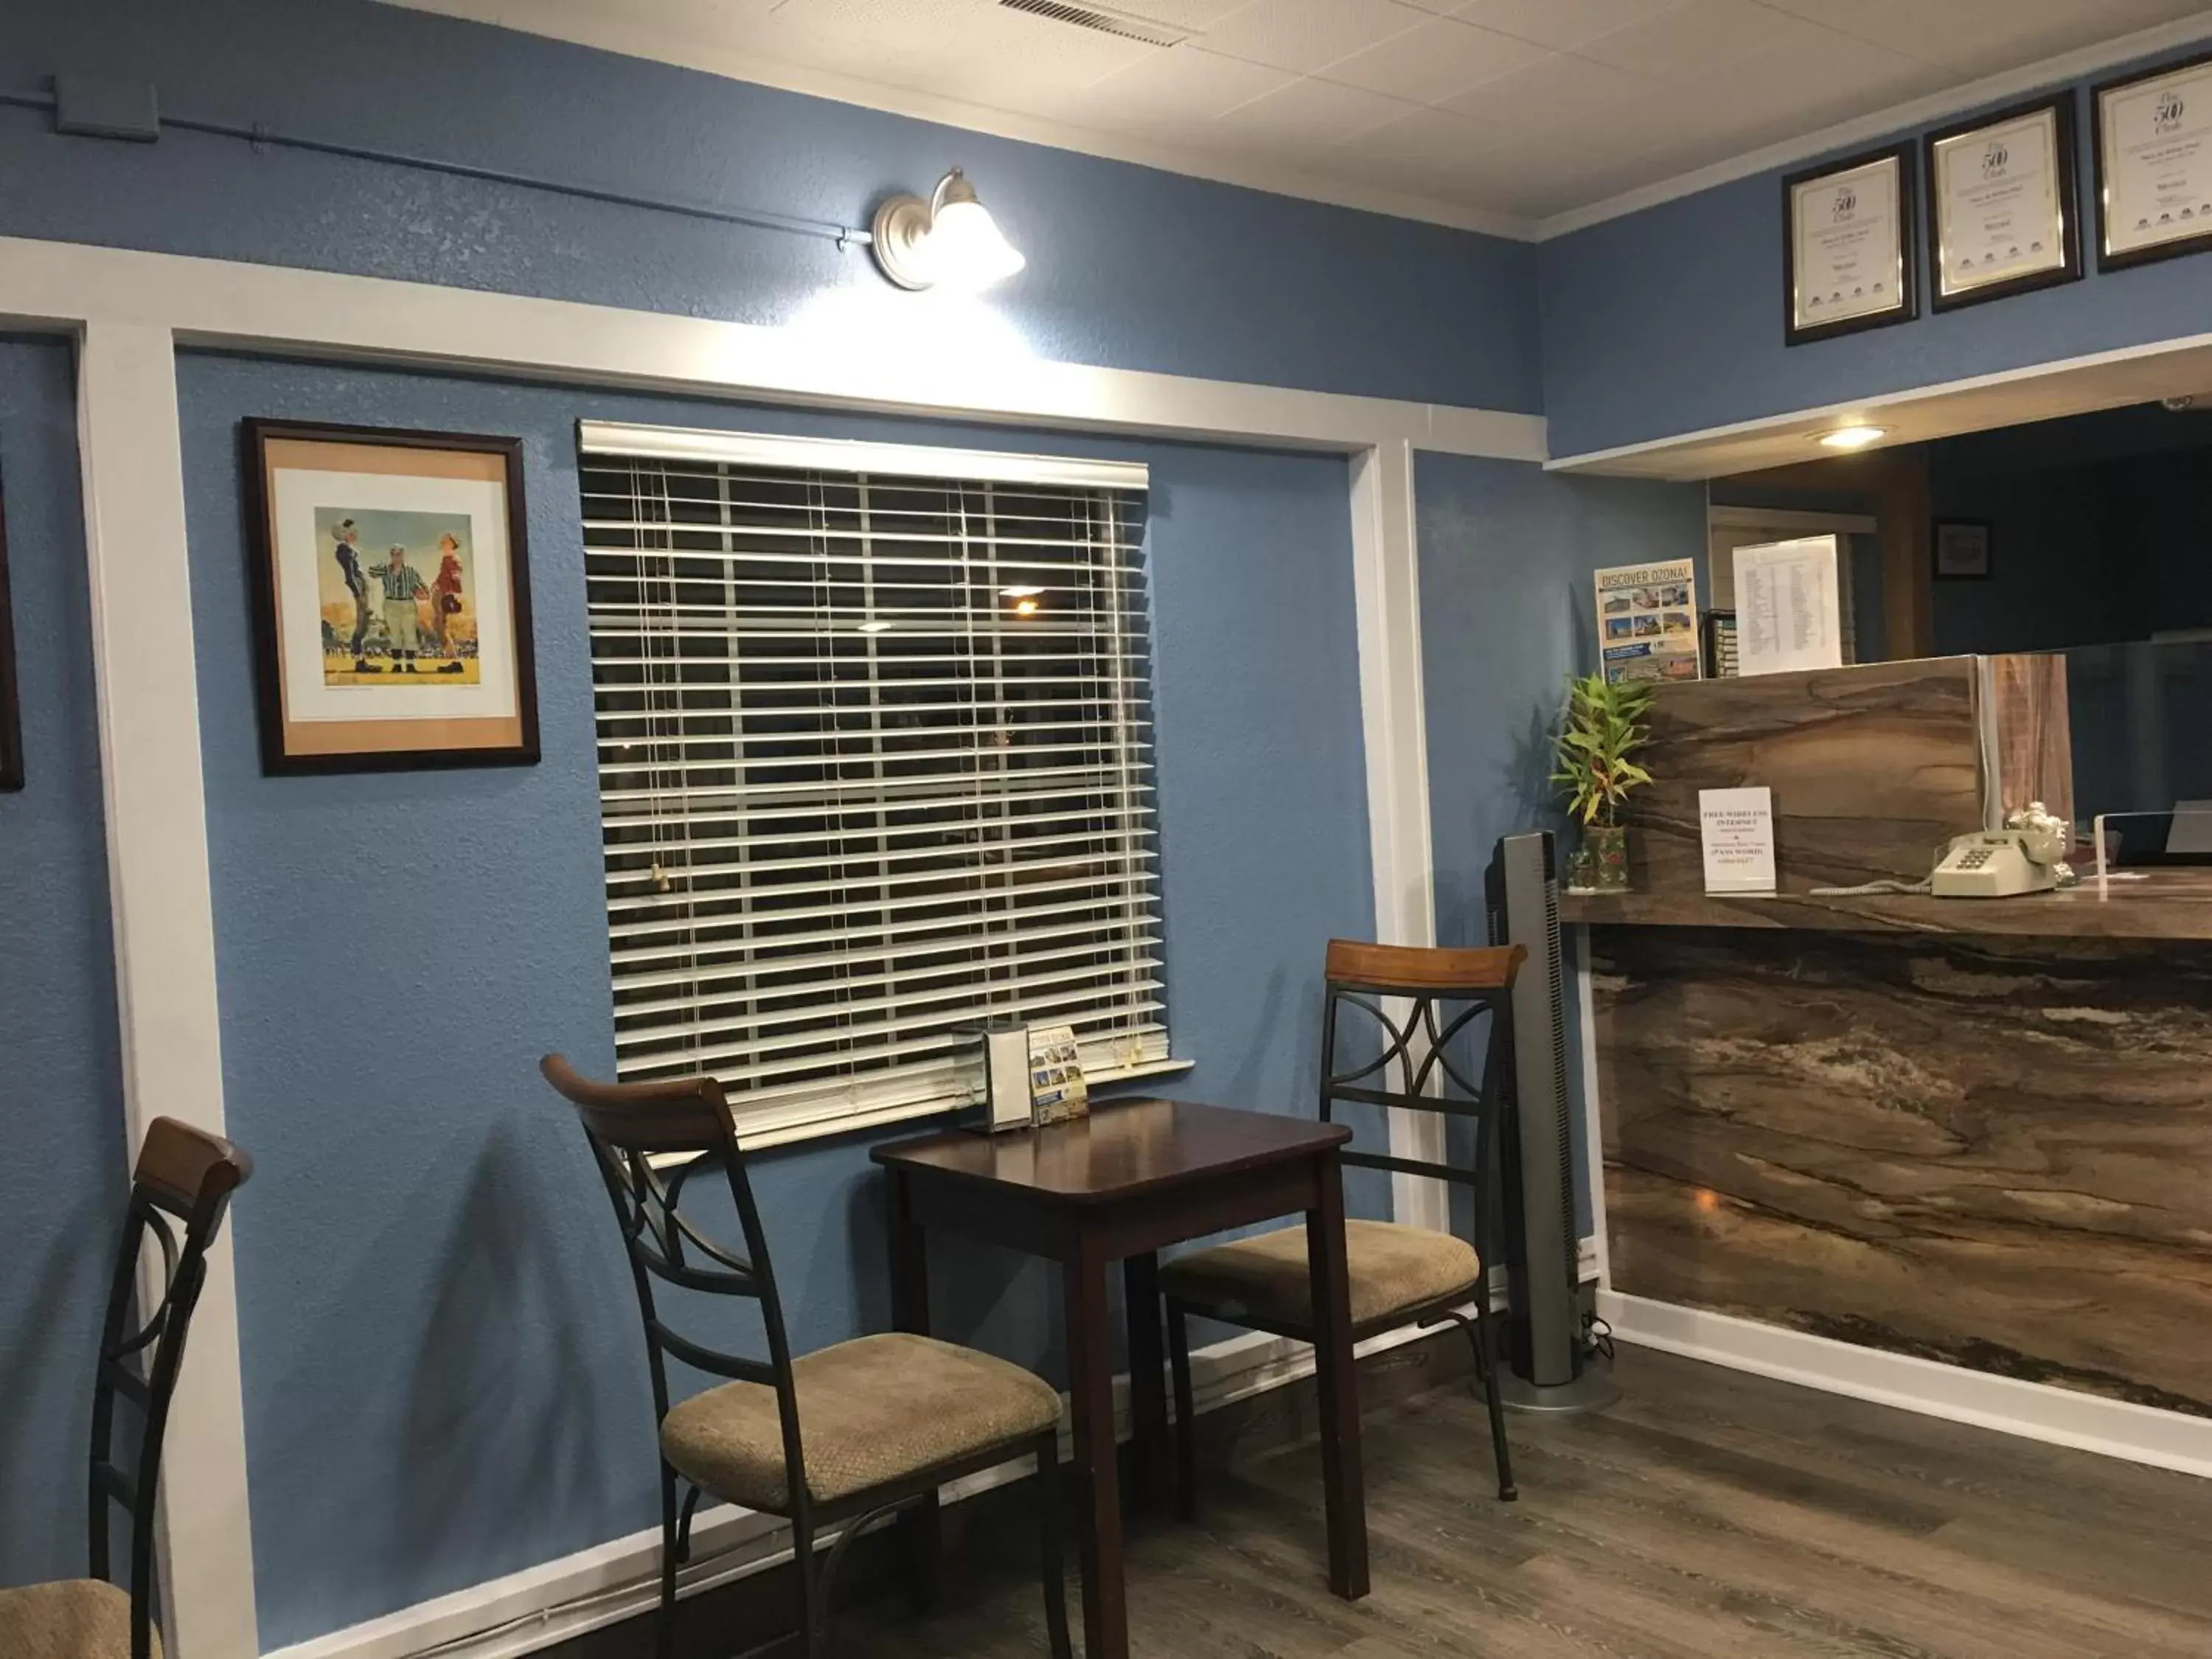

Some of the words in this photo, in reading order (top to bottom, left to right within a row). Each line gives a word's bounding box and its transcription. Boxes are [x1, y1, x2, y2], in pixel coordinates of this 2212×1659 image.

[2154, 101, 2183, 122] 500
[1981, 149, 2008, 168] 500
[1831, 195, 1856, 213] 500
[1602, 570, 1649, 588] DISCOVER
